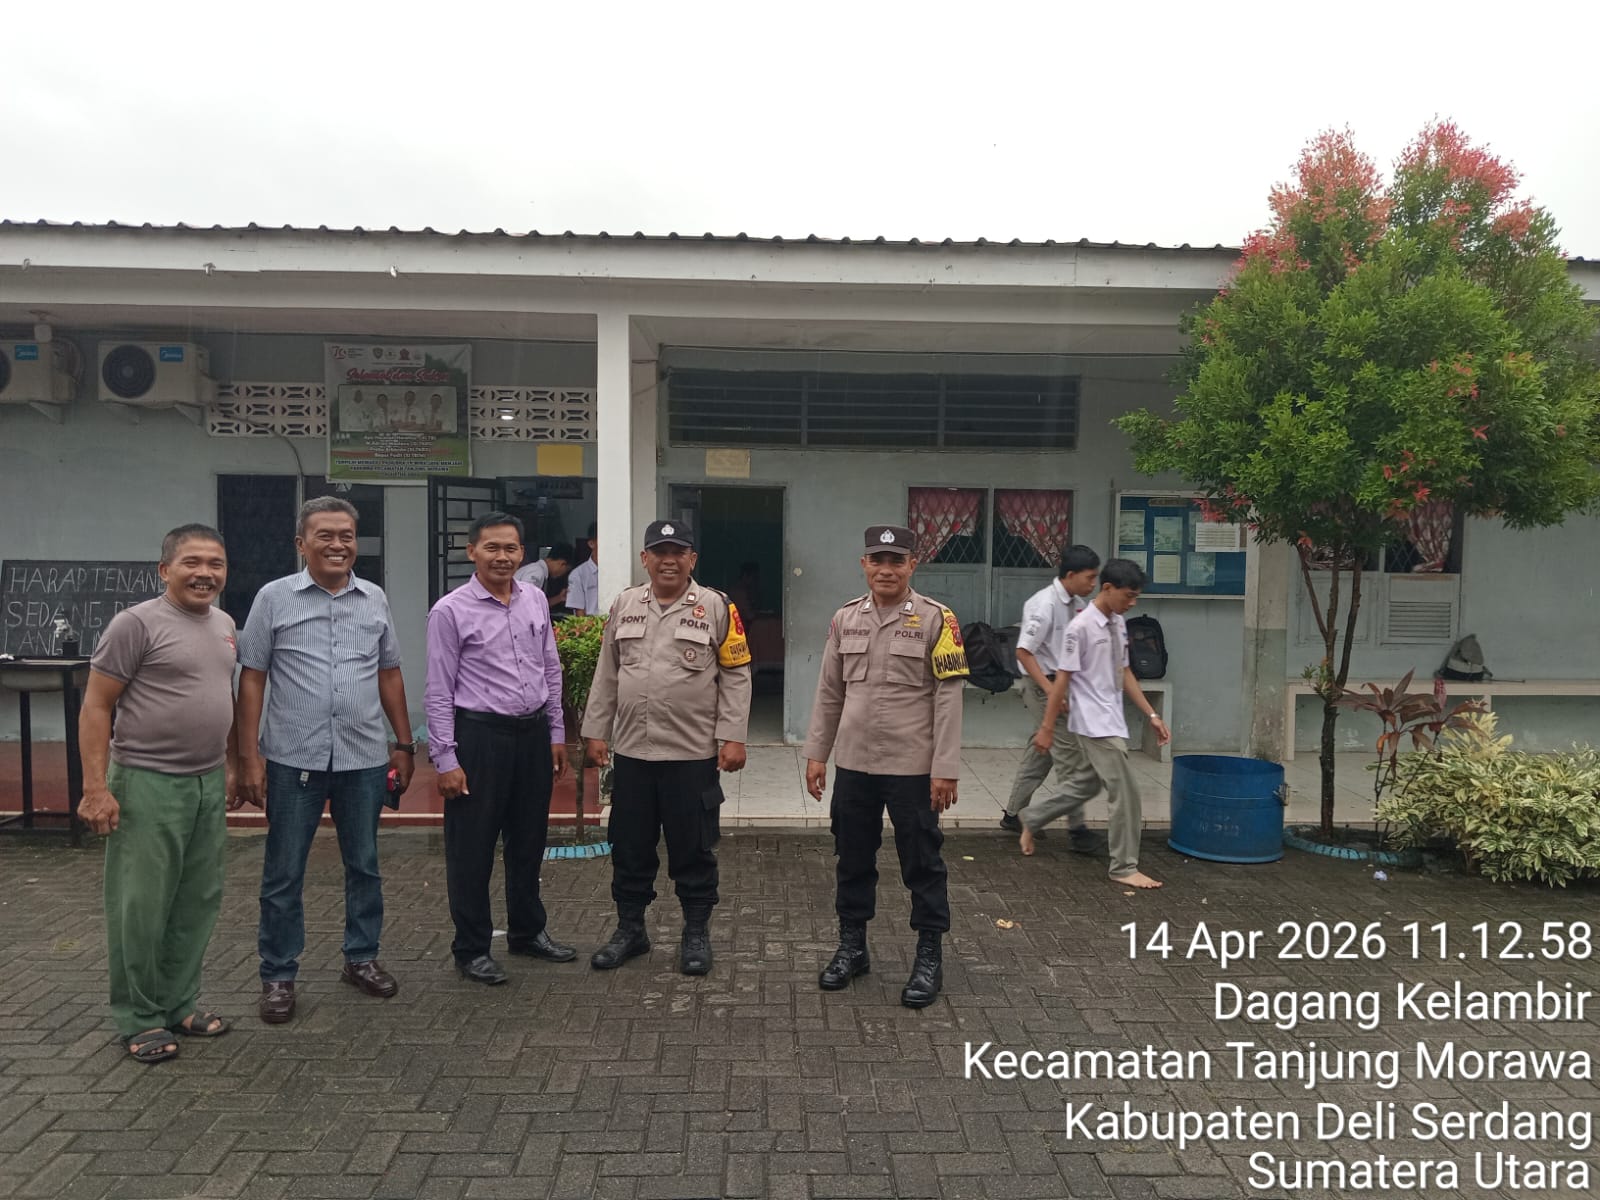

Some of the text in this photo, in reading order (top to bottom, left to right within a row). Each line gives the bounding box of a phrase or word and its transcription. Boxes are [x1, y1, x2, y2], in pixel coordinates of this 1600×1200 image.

[9, 567, 87, 593] HARAP
[5, 601, 103, 628] SEDANG
[621, 615, 647, 625] SONY
[680, 618, 710, 631] POLRI
[894, 630, 924, 640] POLRI
